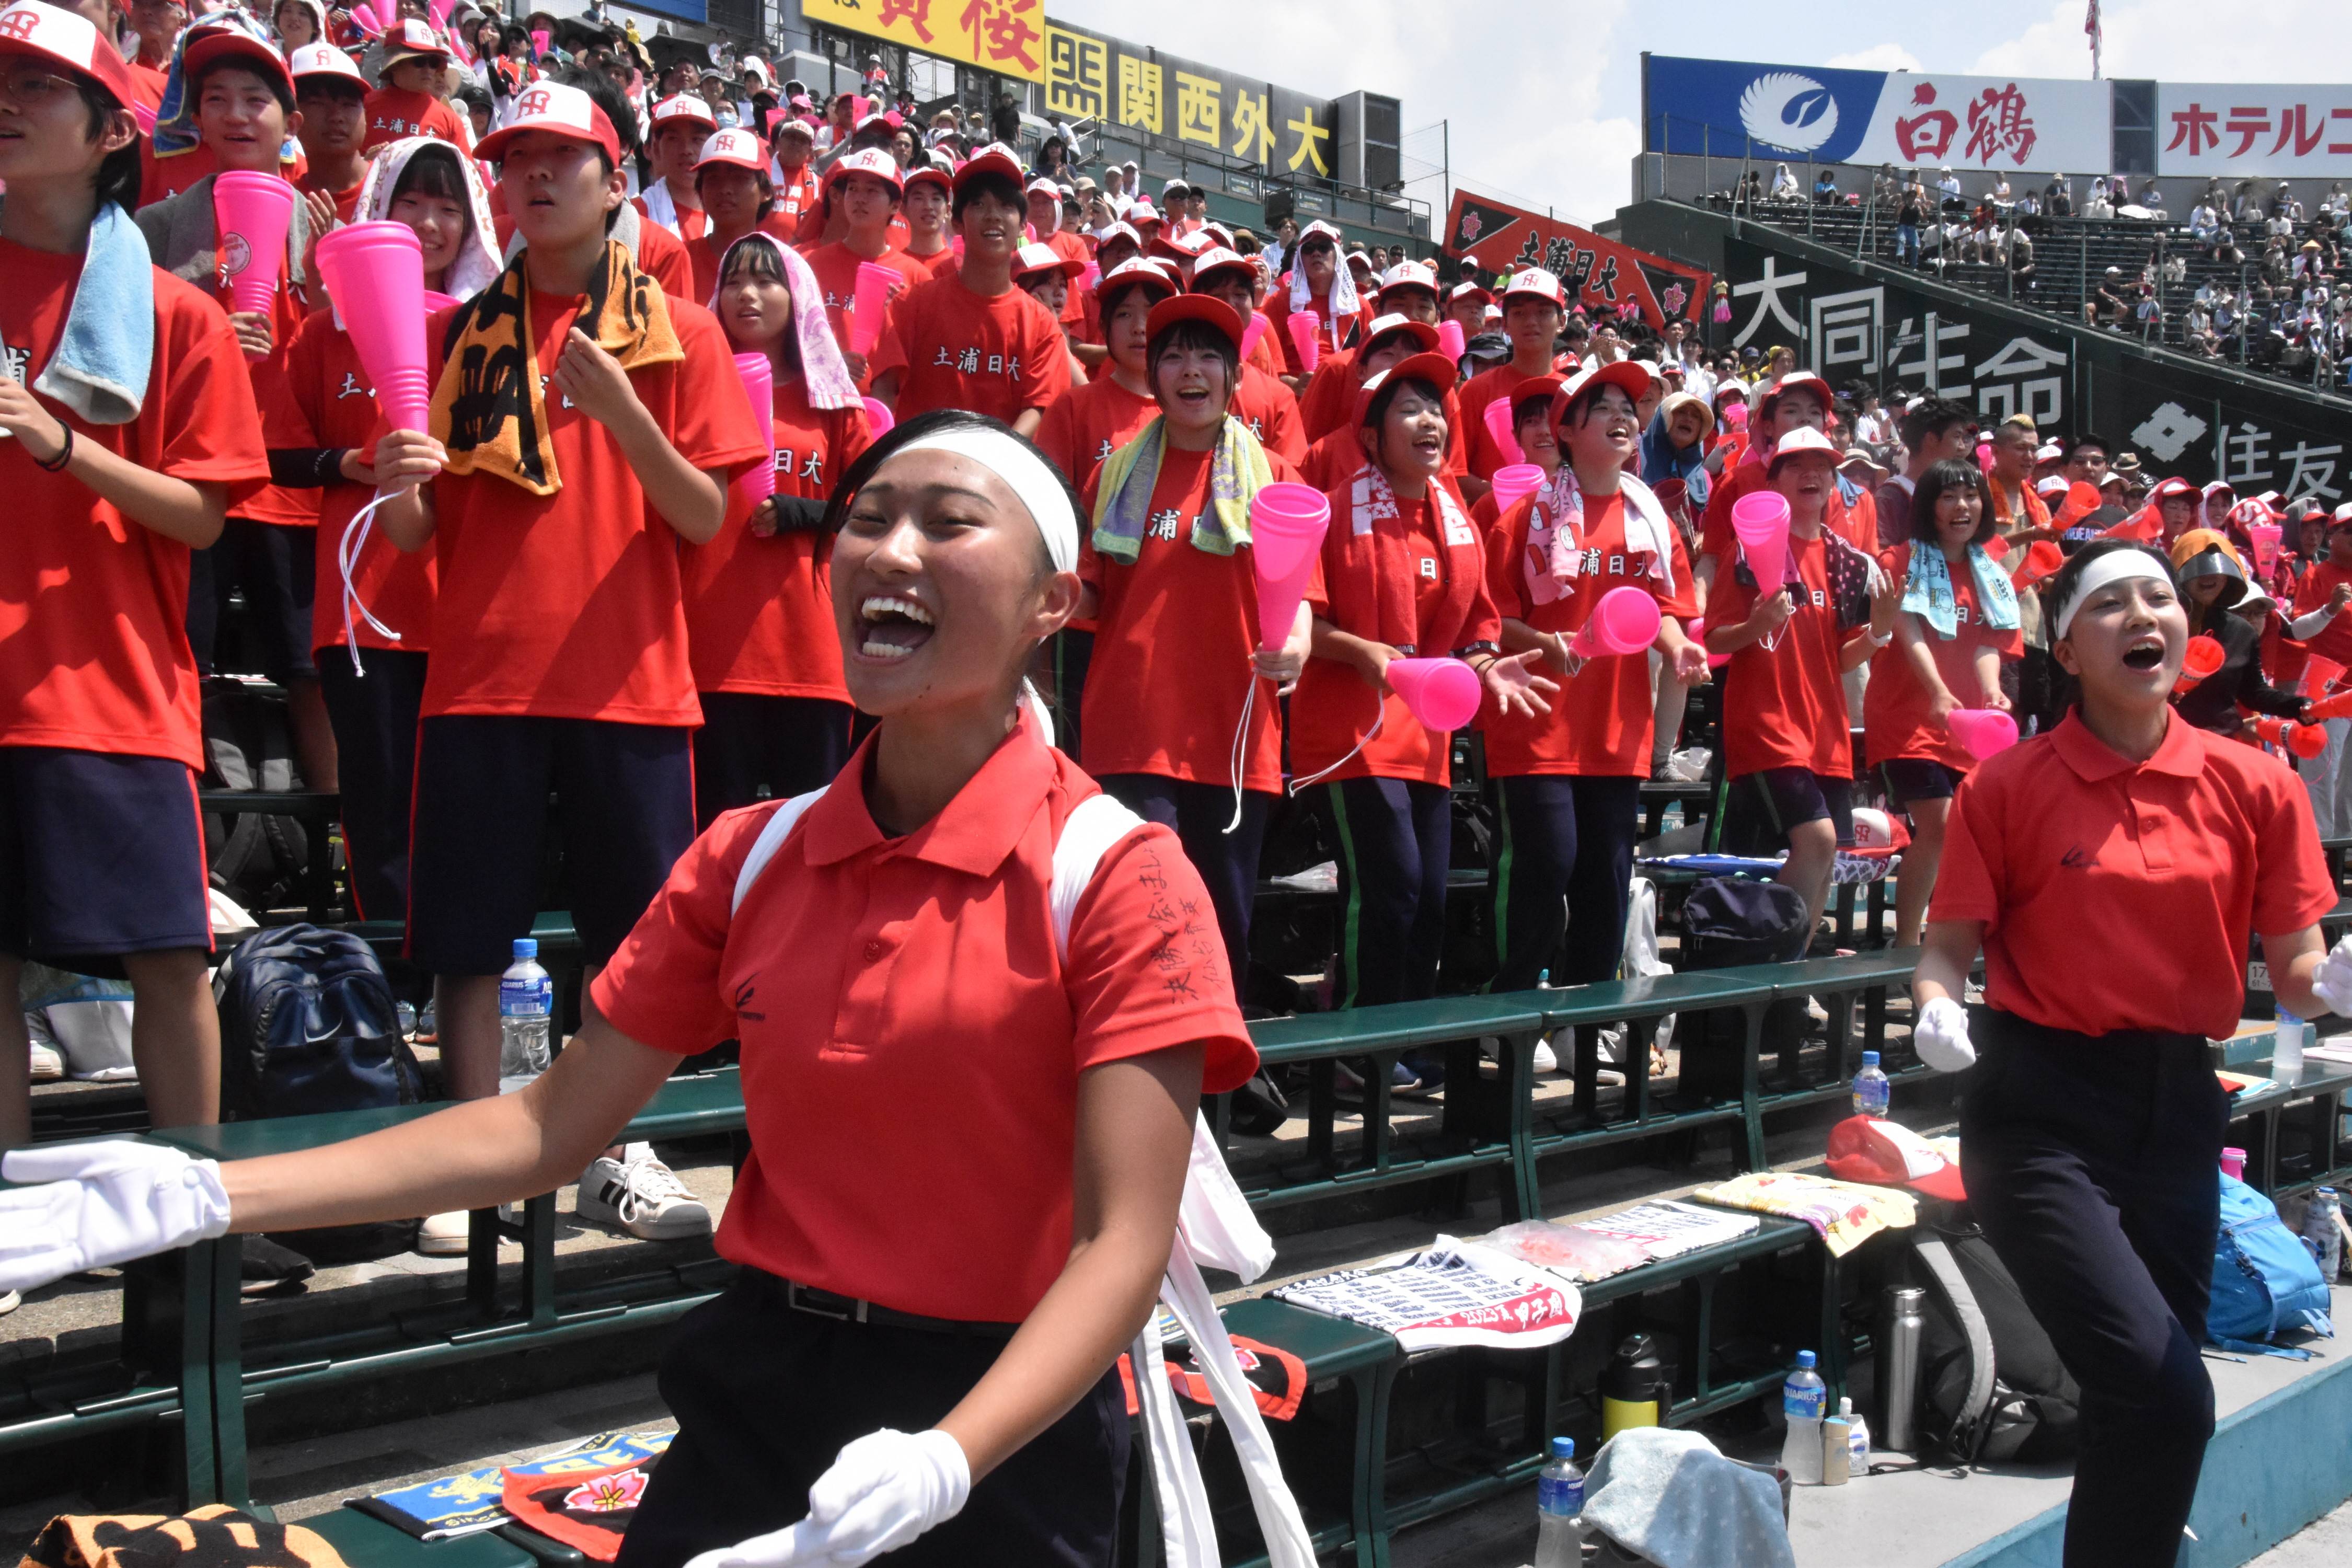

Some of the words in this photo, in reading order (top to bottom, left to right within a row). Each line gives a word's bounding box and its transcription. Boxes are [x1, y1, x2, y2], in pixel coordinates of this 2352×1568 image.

[373, 117, 436, 139] 土浦日大
[1119, 54, 1329, 177] 関西外大
[1895, 82, 2037, 167] 白鶴
[1516, 230, 1618, 301] 土浦日大
[933, 346, 1021, 382] 土浦日大
[1733, 256, 2067, 426] 大同生命
[1179, 896, 1226, 991] 仙台育英
